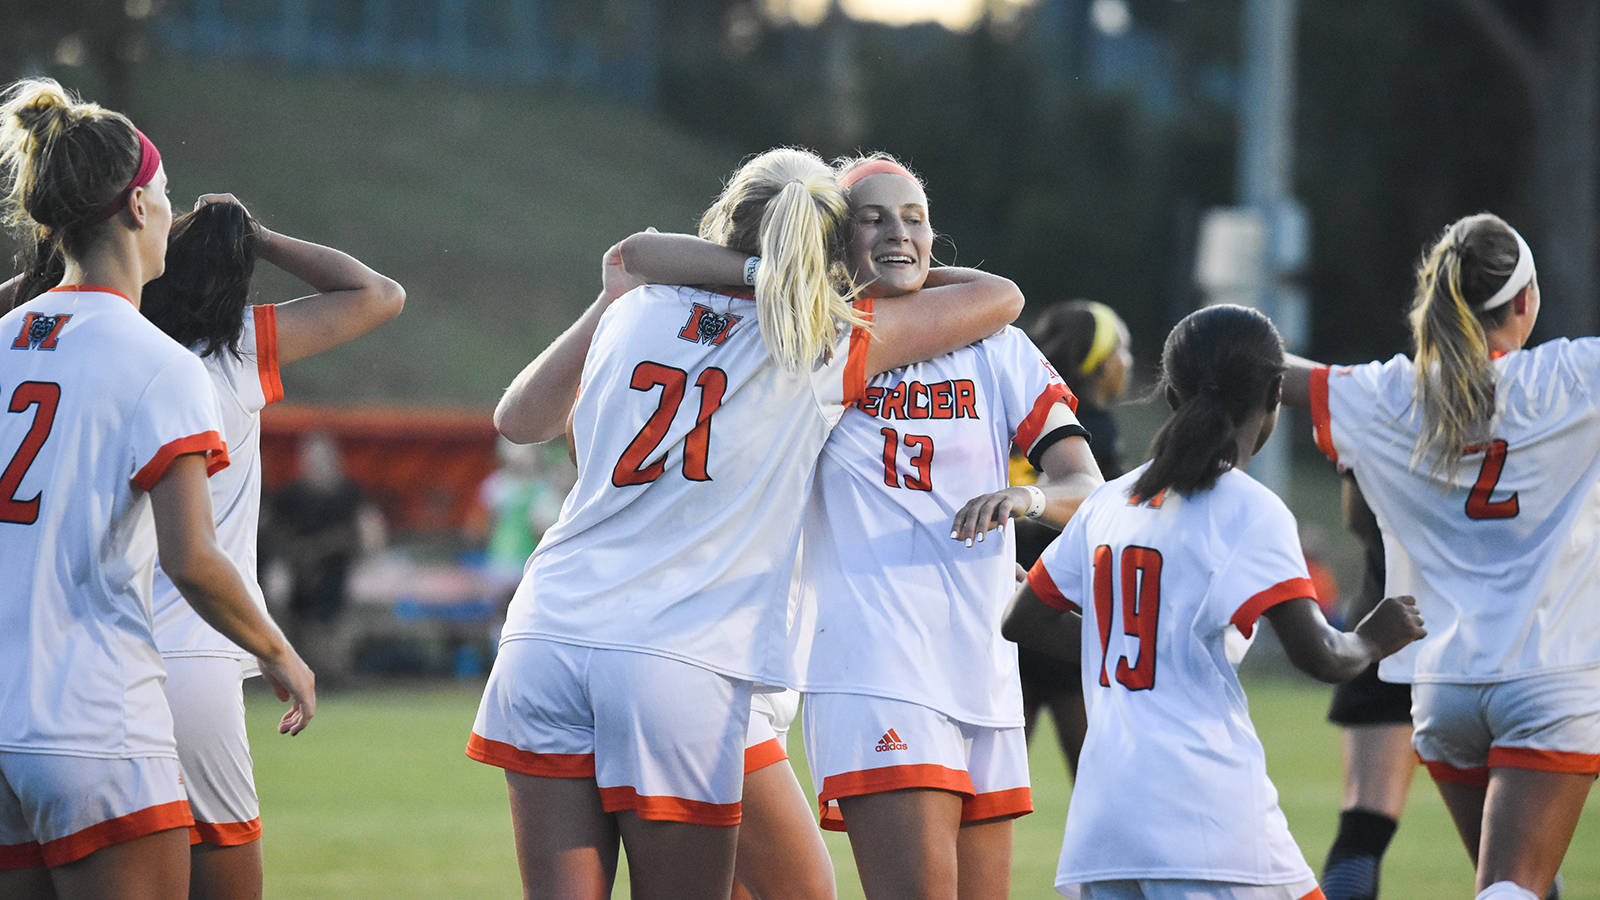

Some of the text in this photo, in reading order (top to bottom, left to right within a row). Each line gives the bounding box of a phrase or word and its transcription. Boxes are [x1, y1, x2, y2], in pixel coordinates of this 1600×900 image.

[612, 361, 728, 488] 21
[857, 379, 980, 420] ERCER
[881, 427, 934, 493] 13
[1463, 438, 1520, 521] 2
[1093, 544, 1164, 692] 19
[875, 742, 909, 753] adidas
